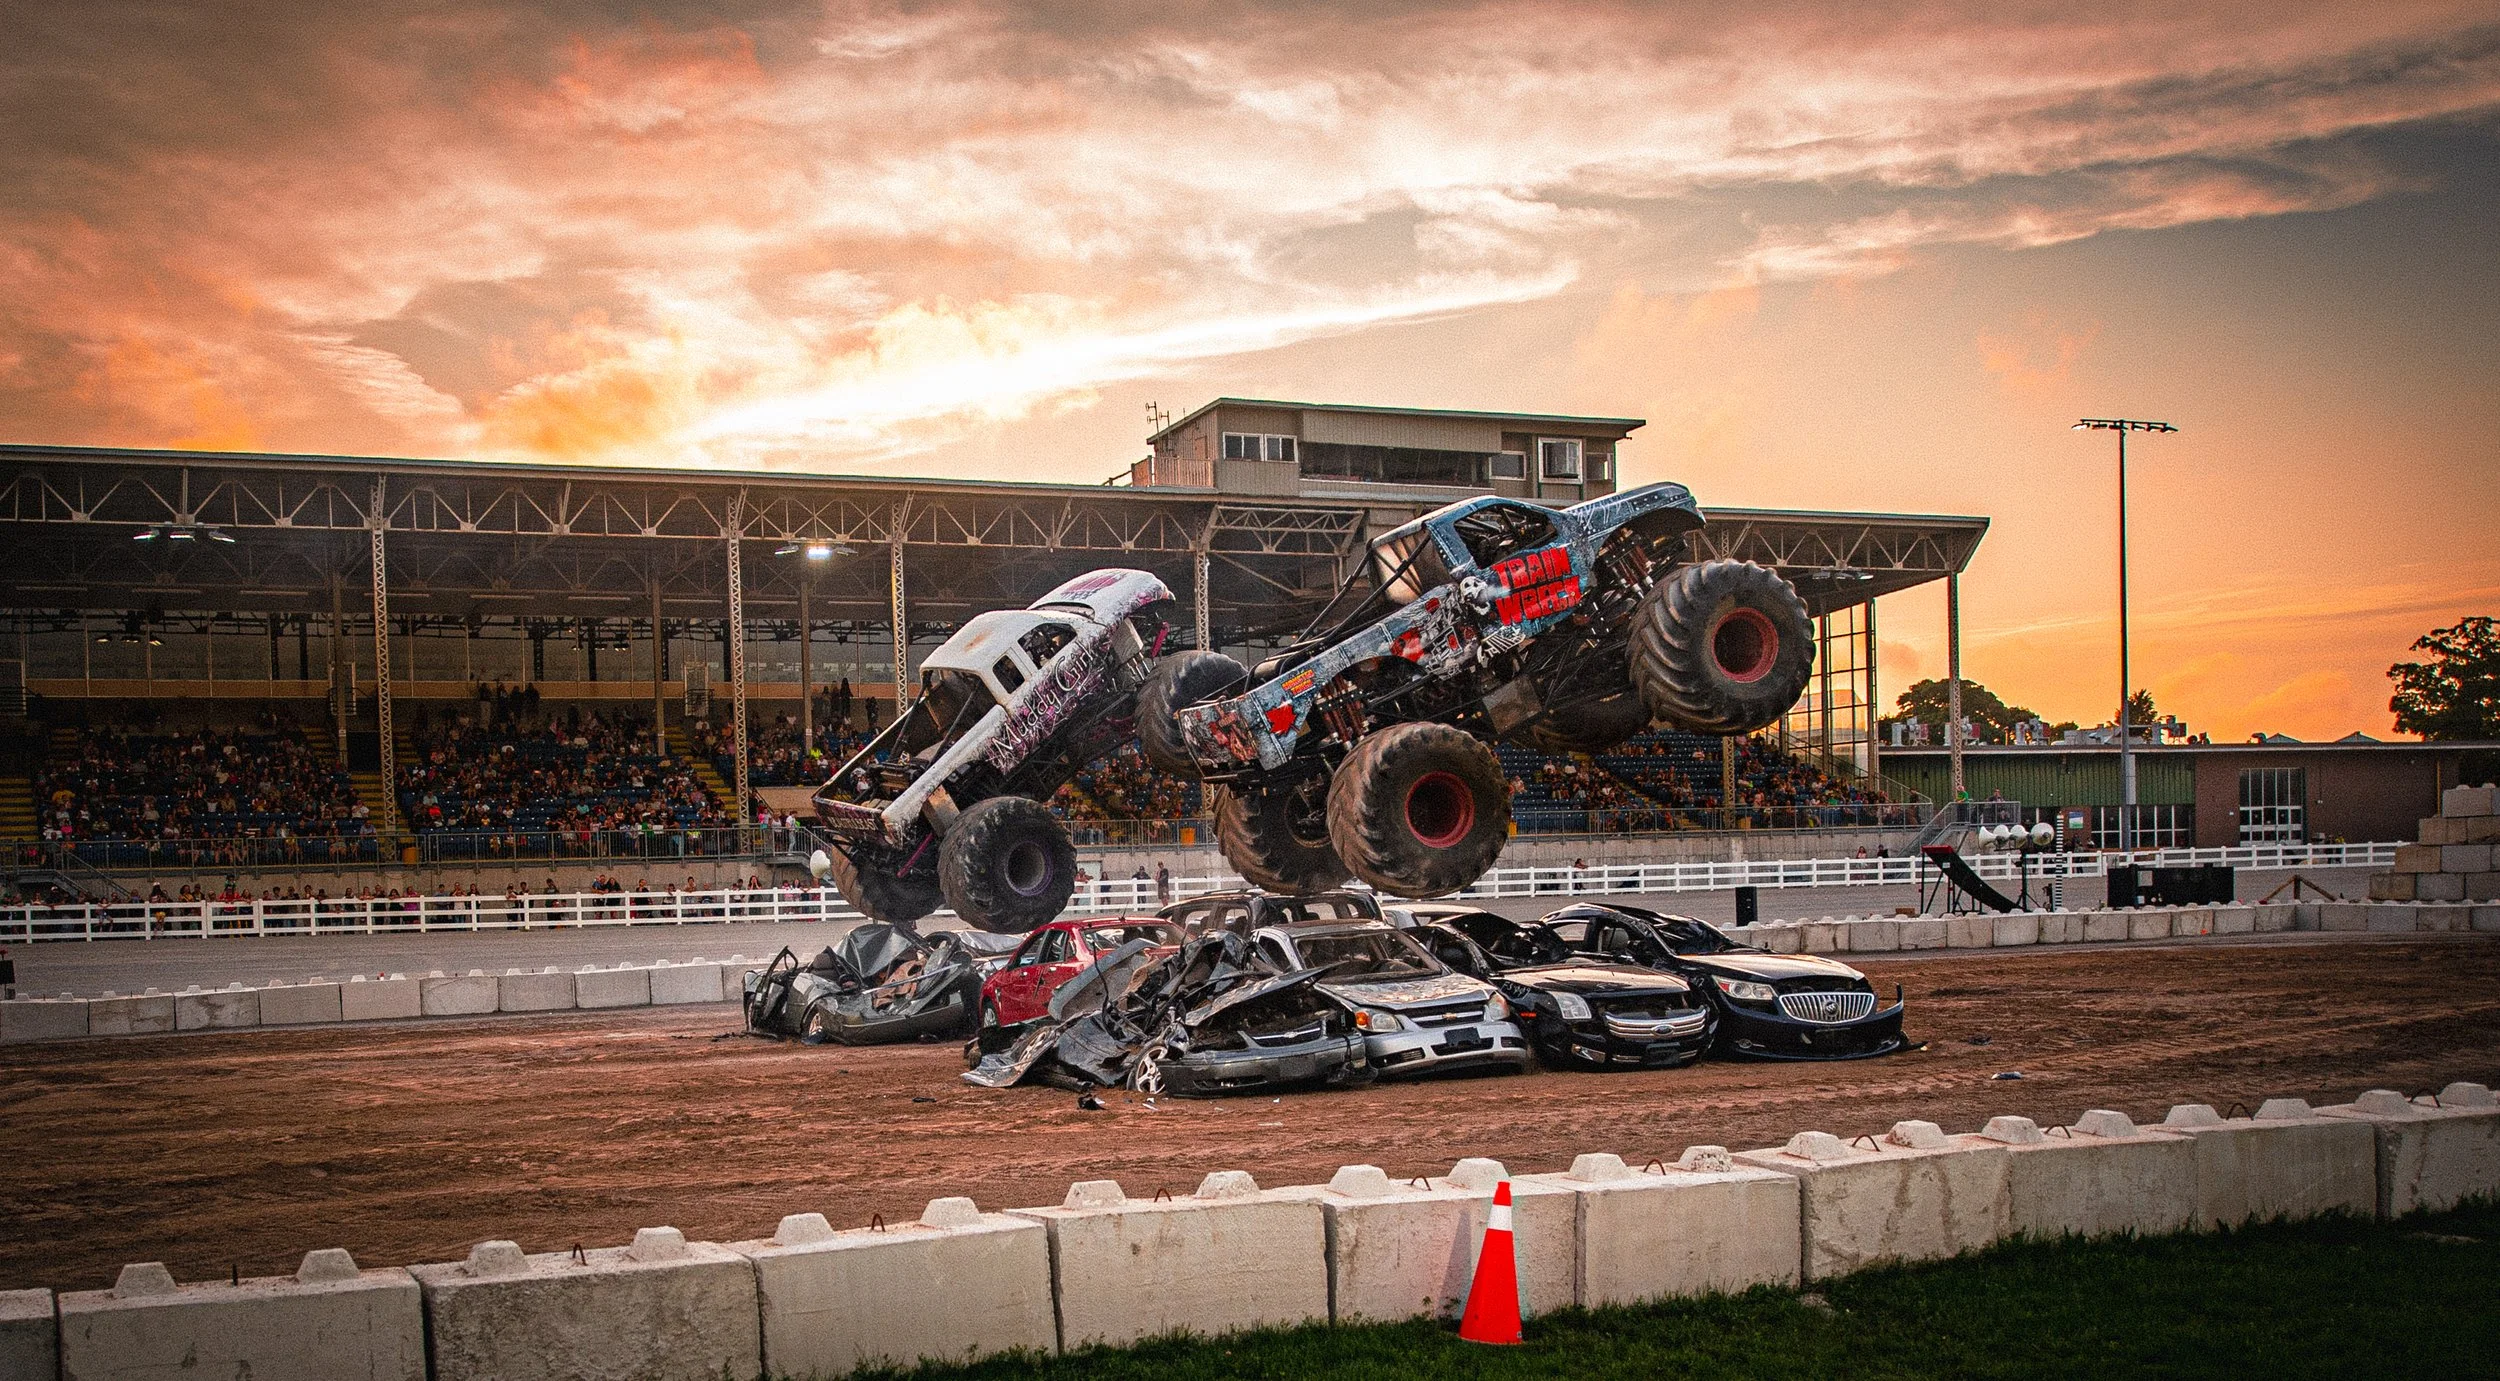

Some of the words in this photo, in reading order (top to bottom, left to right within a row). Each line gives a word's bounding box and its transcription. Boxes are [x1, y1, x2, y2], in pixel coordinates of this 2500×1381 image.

[1492, 546, 1571, 588] TRAIN
[1495, 575, 1582, 627] WRECK
[991, 687, 1062, 760] Muddy
[1056, 641, 1093, 691] Girl
